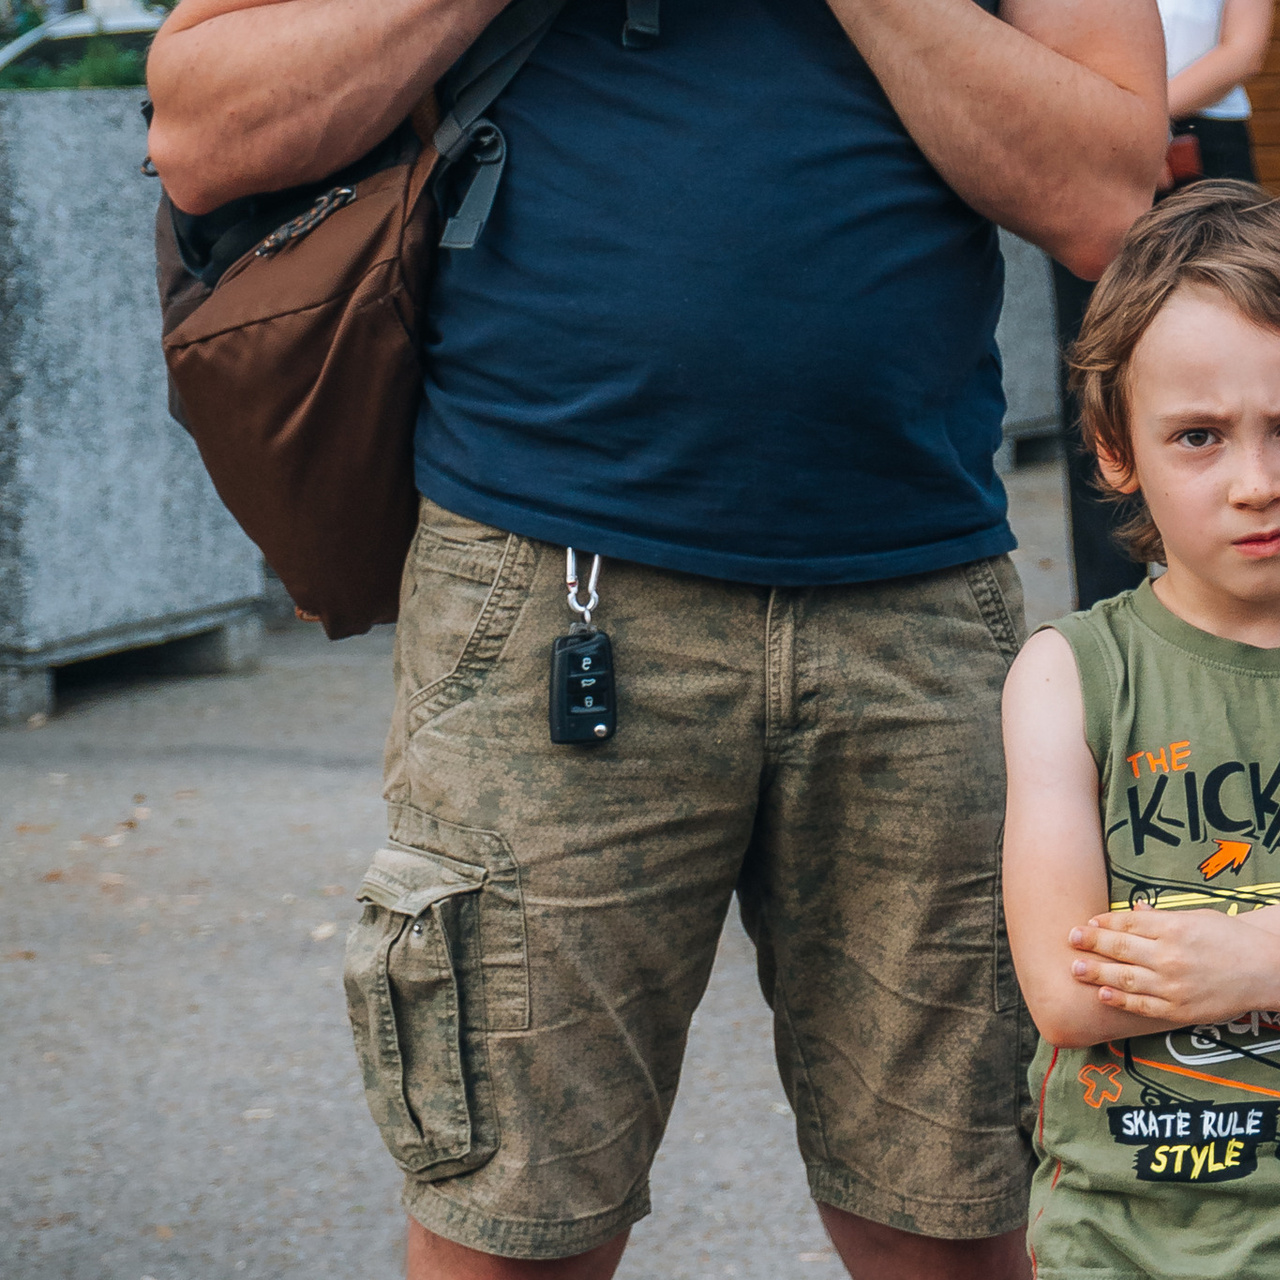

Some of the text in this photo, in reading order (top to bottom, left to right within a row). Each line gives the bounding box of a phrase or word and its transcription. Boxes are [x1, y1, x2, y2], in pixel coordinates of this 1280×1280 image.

[1126, 741, 1192, 779] THE
[1121, 1107, 1264, 1138] SKATE RULE
[1150, 1140, 1245, 1180] STYLE
